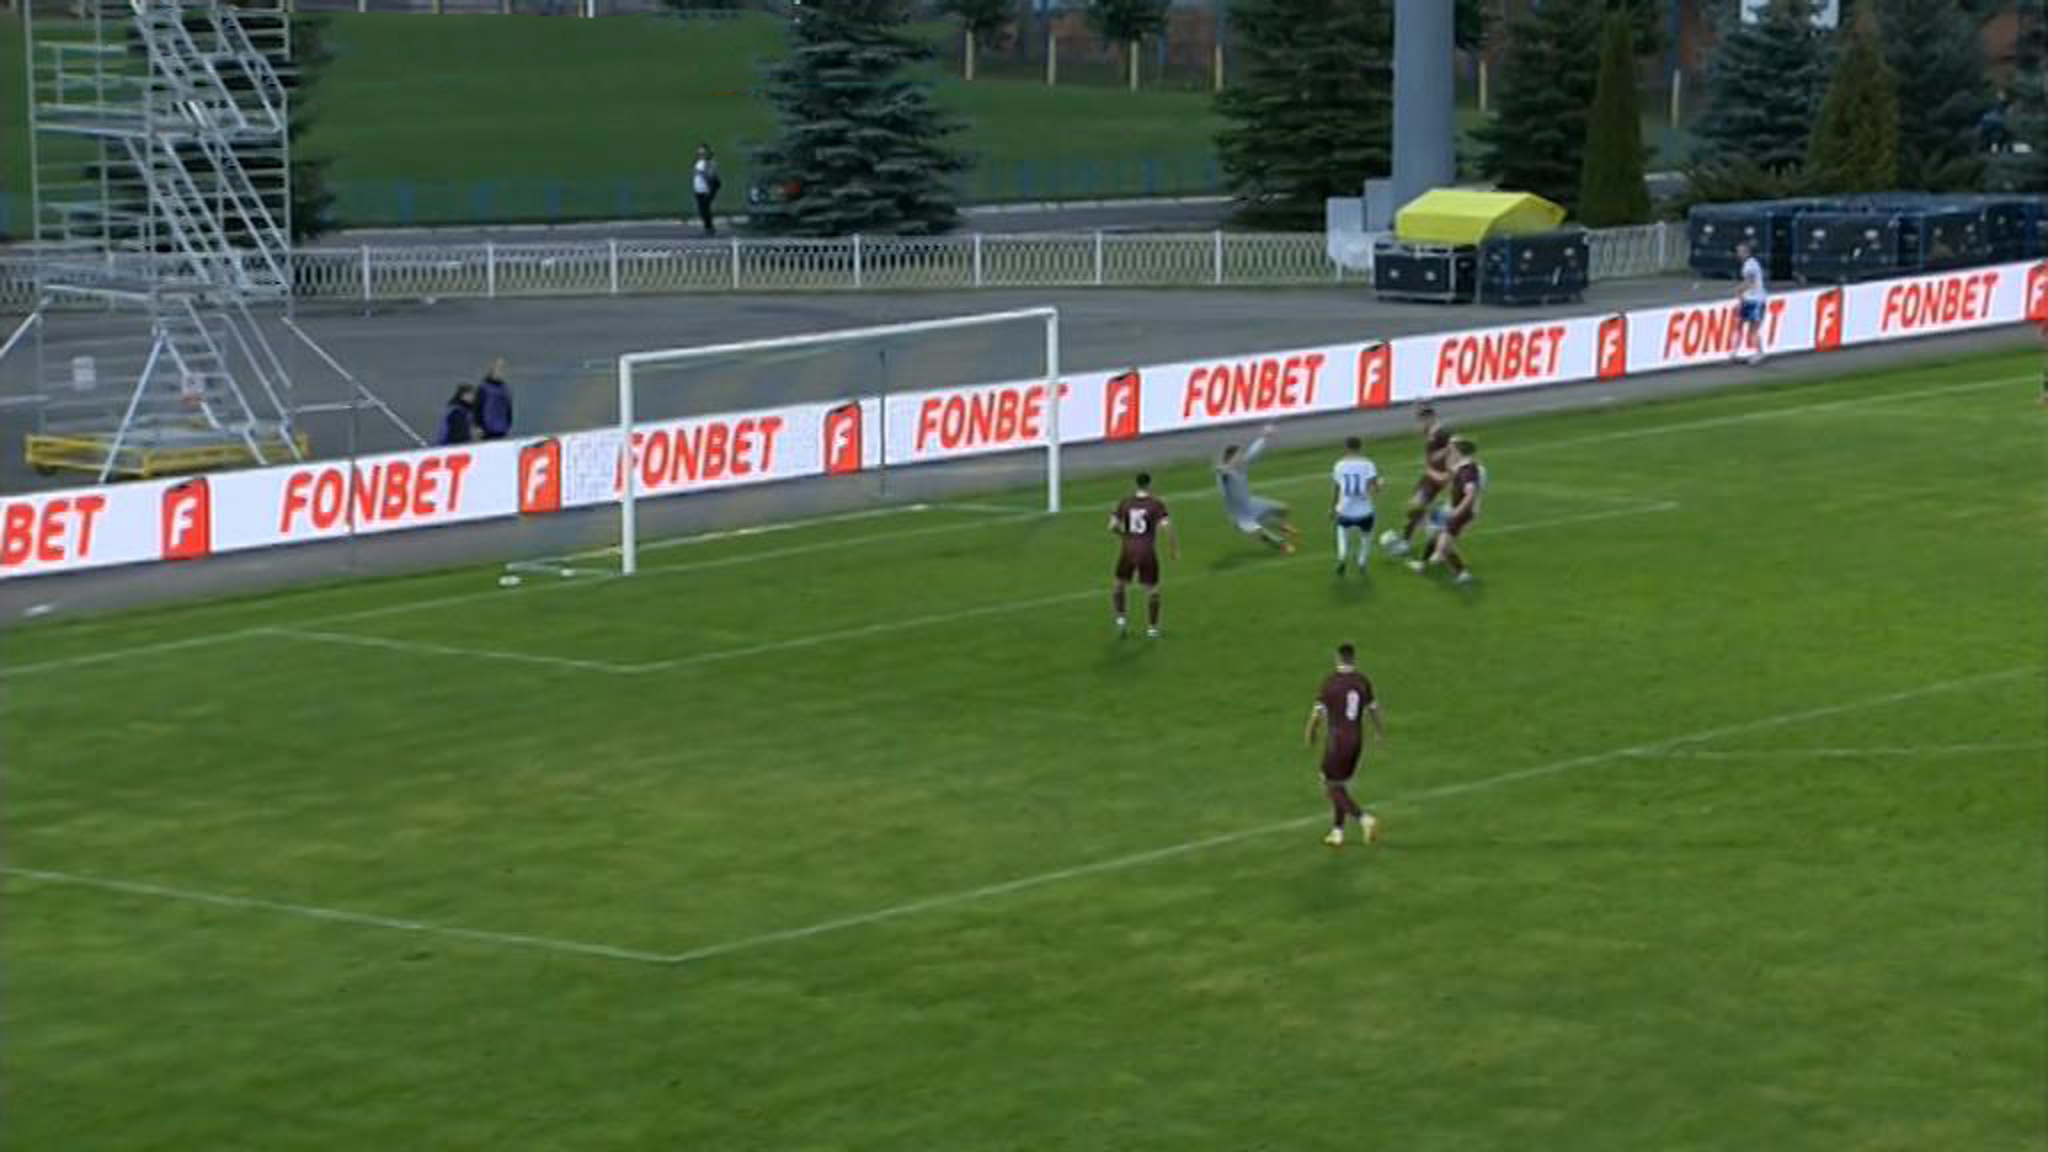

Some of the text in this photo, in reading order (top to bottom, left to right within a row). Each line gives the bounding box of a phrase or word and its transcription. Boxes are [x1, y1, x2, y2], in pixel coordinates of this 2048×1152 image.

[1883, 273, 1999, 331] FONBET
[1185, 354, 1325, 420] FONBET
[1437, 328, 1566, 387] FONBET
[281, 453, 472, 535] FONBET
[1343, 473, 1362, 497] 11
[0, 495, 106, 569] BET
